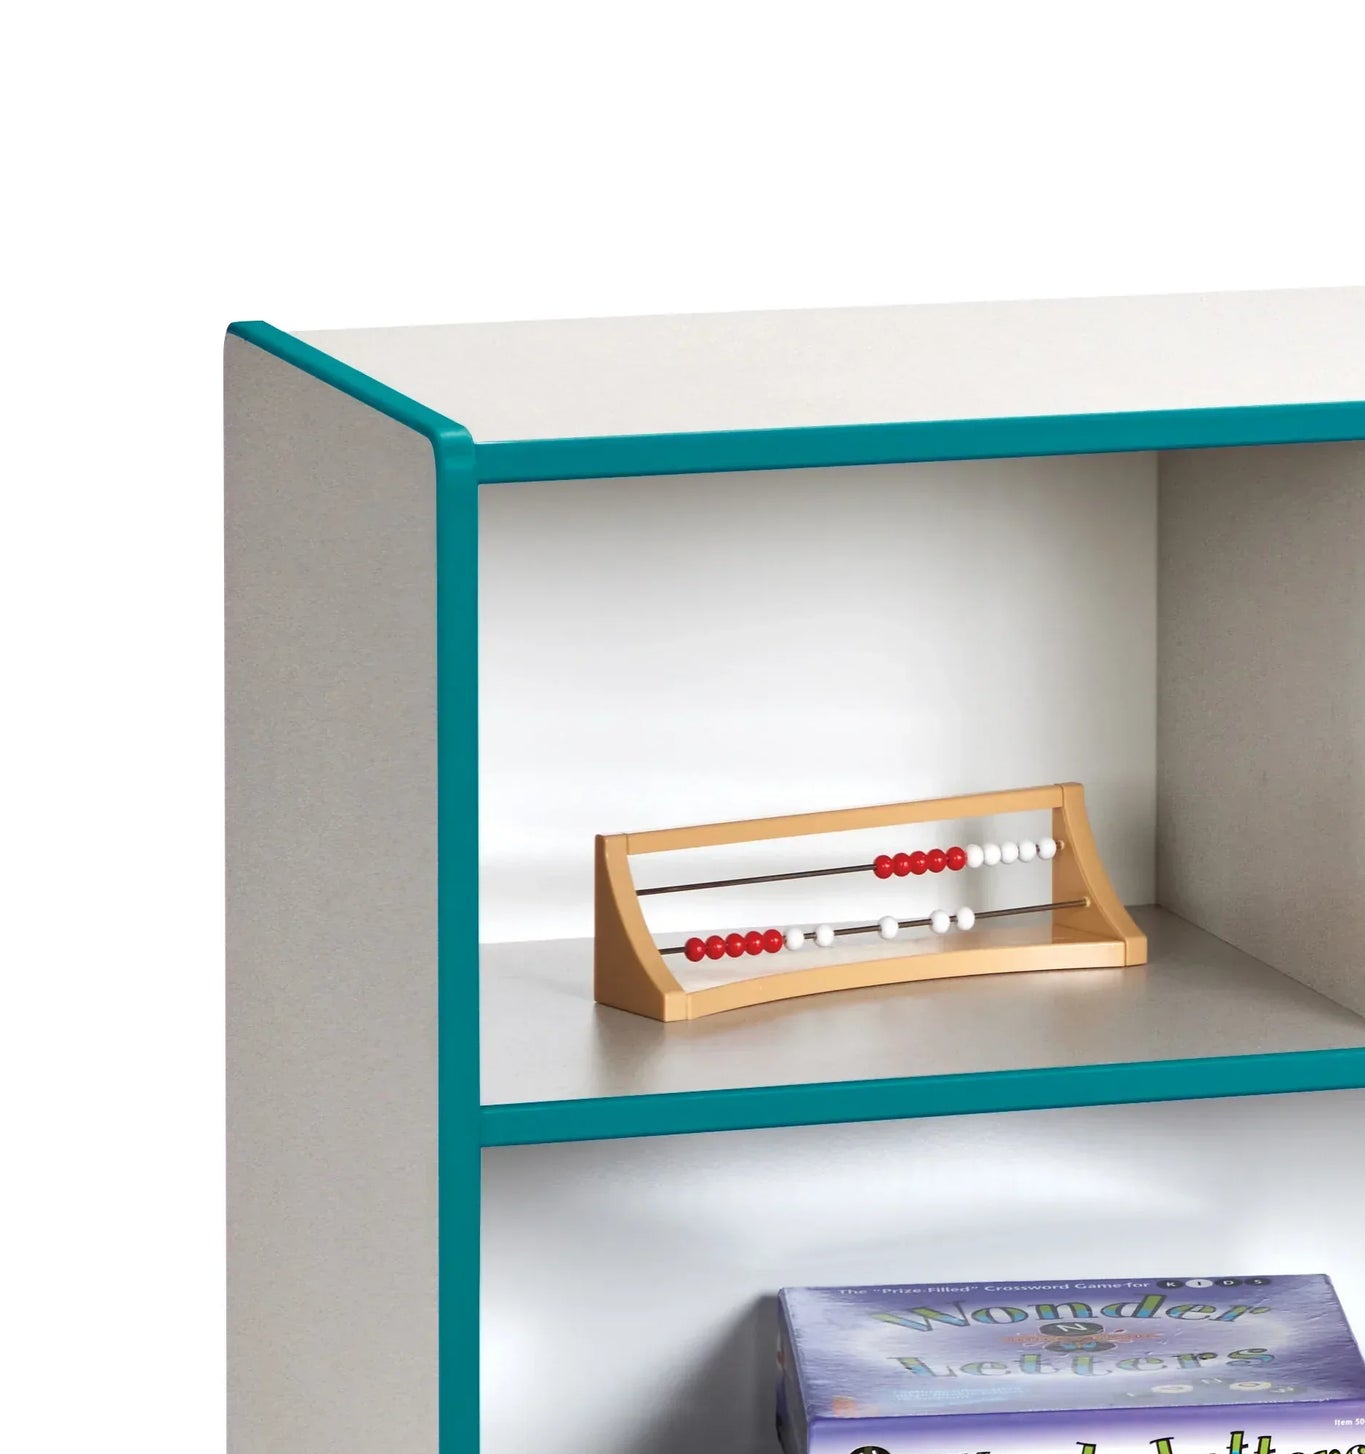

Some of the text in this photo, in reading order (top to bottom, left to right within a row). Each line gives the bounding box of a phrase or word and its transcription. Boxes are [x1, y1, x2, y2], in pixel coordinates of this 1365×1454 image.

[984, 1283, 1069, 1292] Crossword
[870, 1294, 1272, 1332] Wonder
[888, 1347, 1277, 1379] Letters
